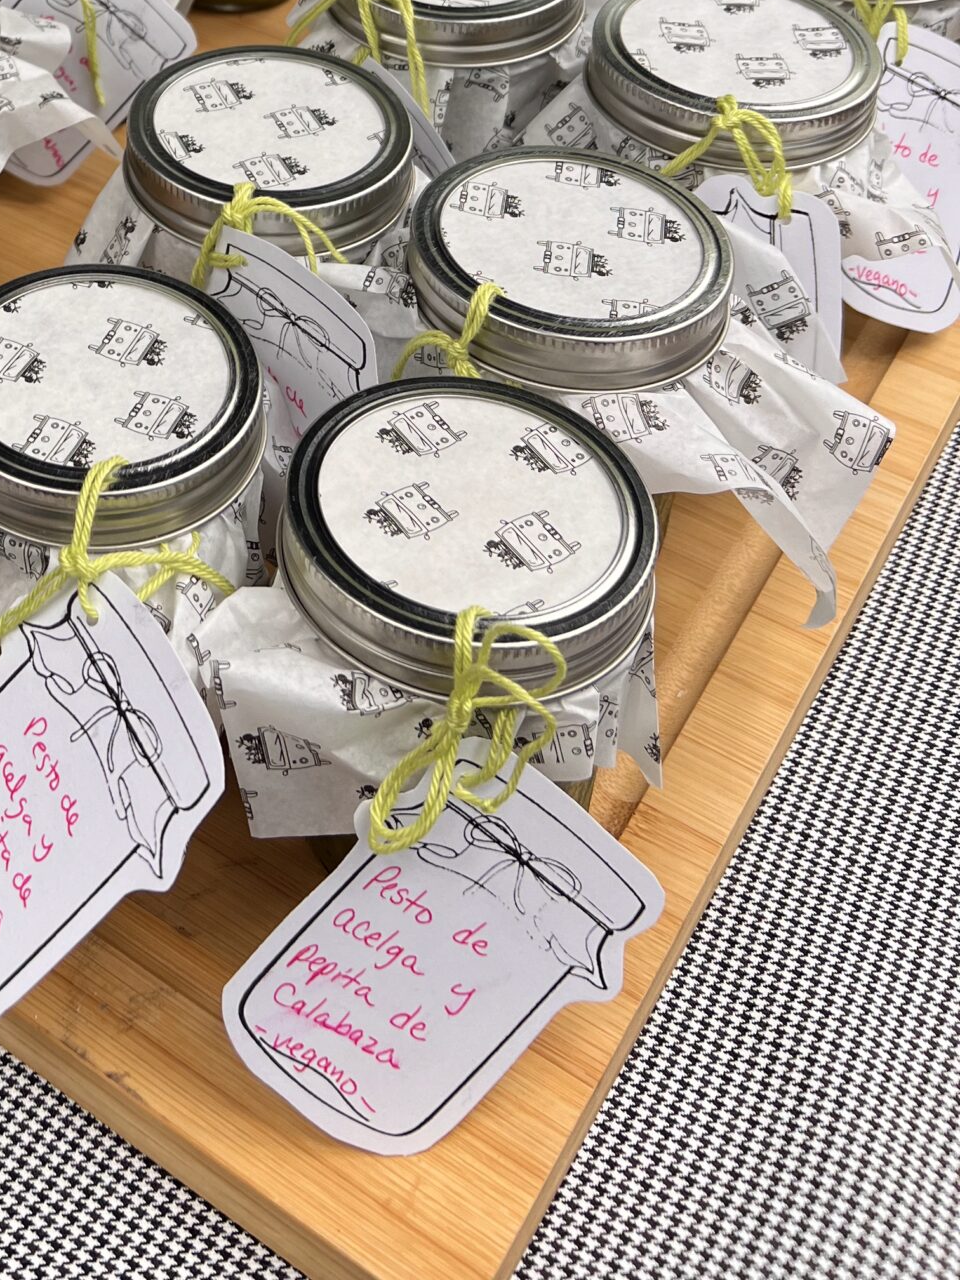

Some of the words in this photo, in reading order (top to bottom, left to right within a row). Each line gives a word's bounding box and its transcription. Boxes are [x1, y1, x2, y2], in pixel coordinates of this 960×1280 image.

[919, 144, 939, 167] de
[61, 794, 79, 837] de
[33, 834, 54, 862] y
[13, 873, 32, 908] de
[362, 865, 433, 924] Pesto
[452, 922, 488, 957] de
[444, 982, 476, 1016] y
[390, 1006, 426, 1043] de
